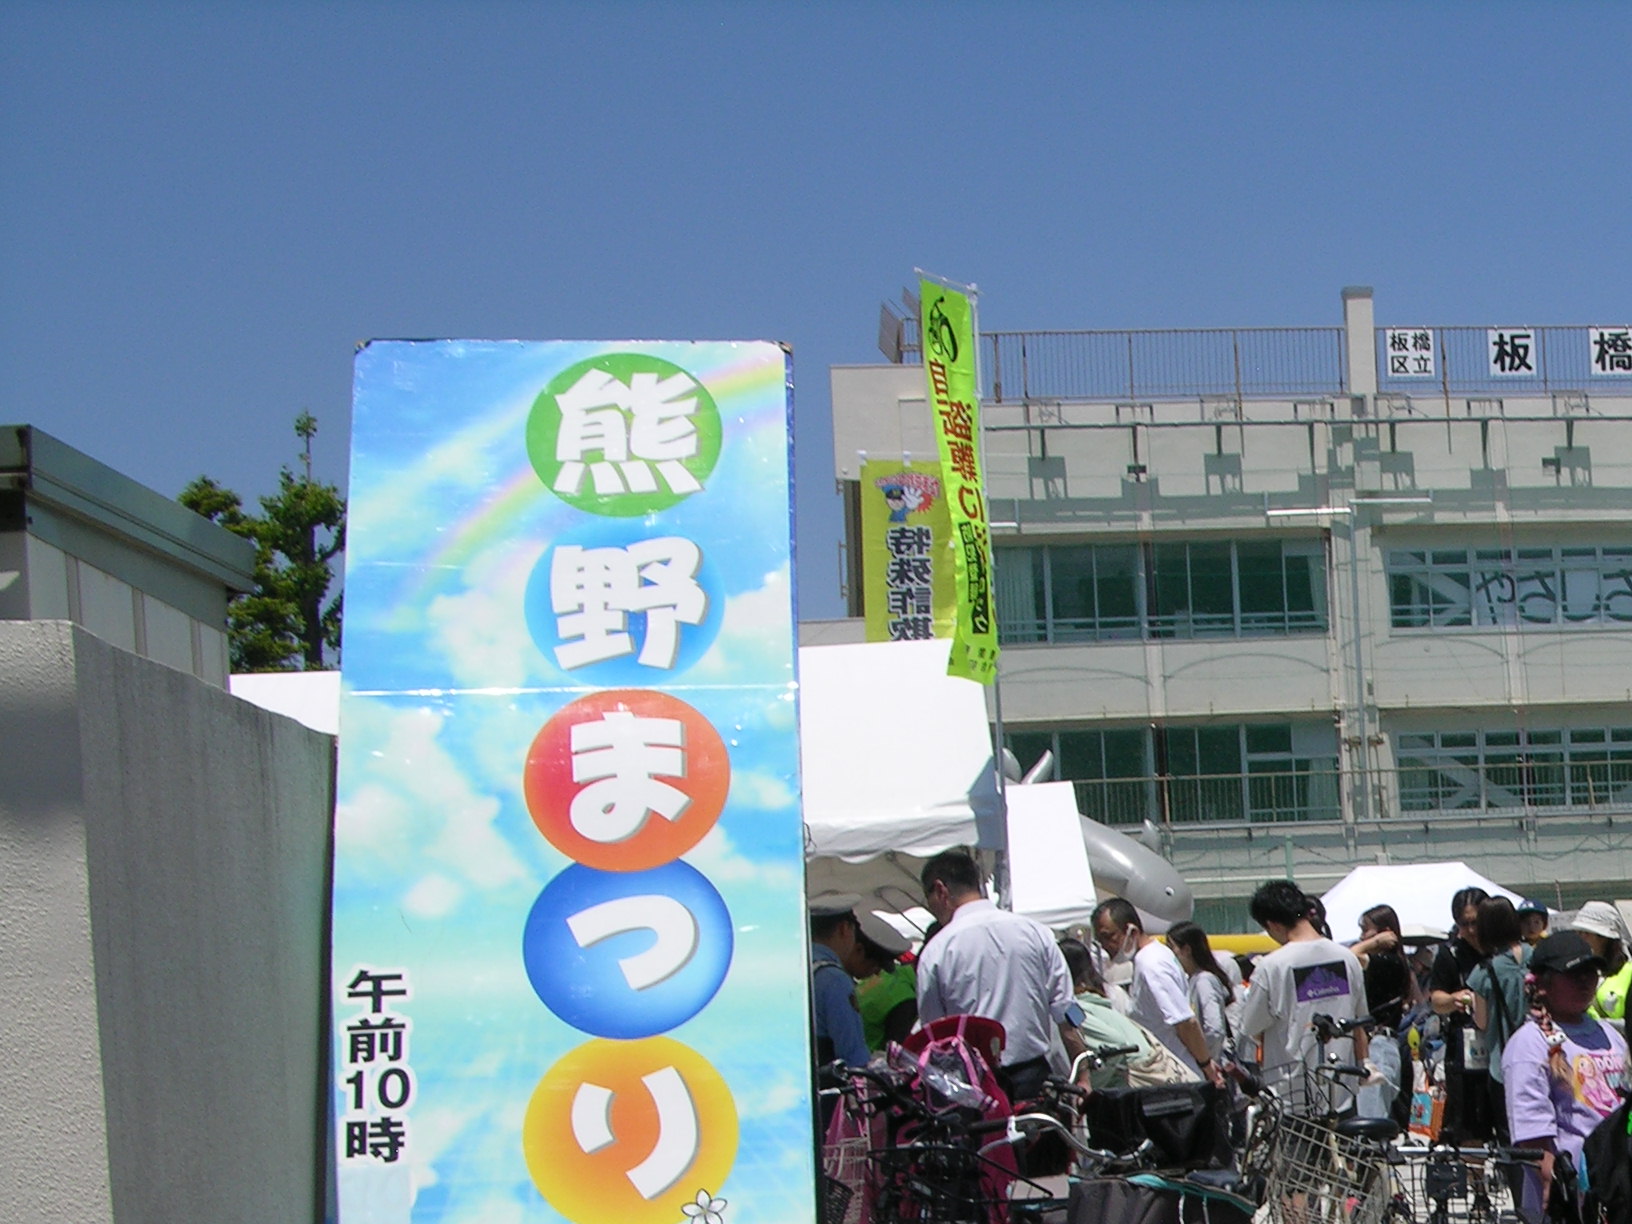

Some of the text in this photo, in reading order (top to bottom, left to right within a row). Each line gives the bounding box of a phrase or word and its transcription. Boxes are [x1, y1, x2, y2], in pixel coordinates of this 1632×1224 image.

[1389, 332, 1431, 351] 板橋
[1390, 354, 1432, 374] 区立
[550, 367, 708, 1200] 熊野まつり
[345, 969, 411, 1163] 午前10時
